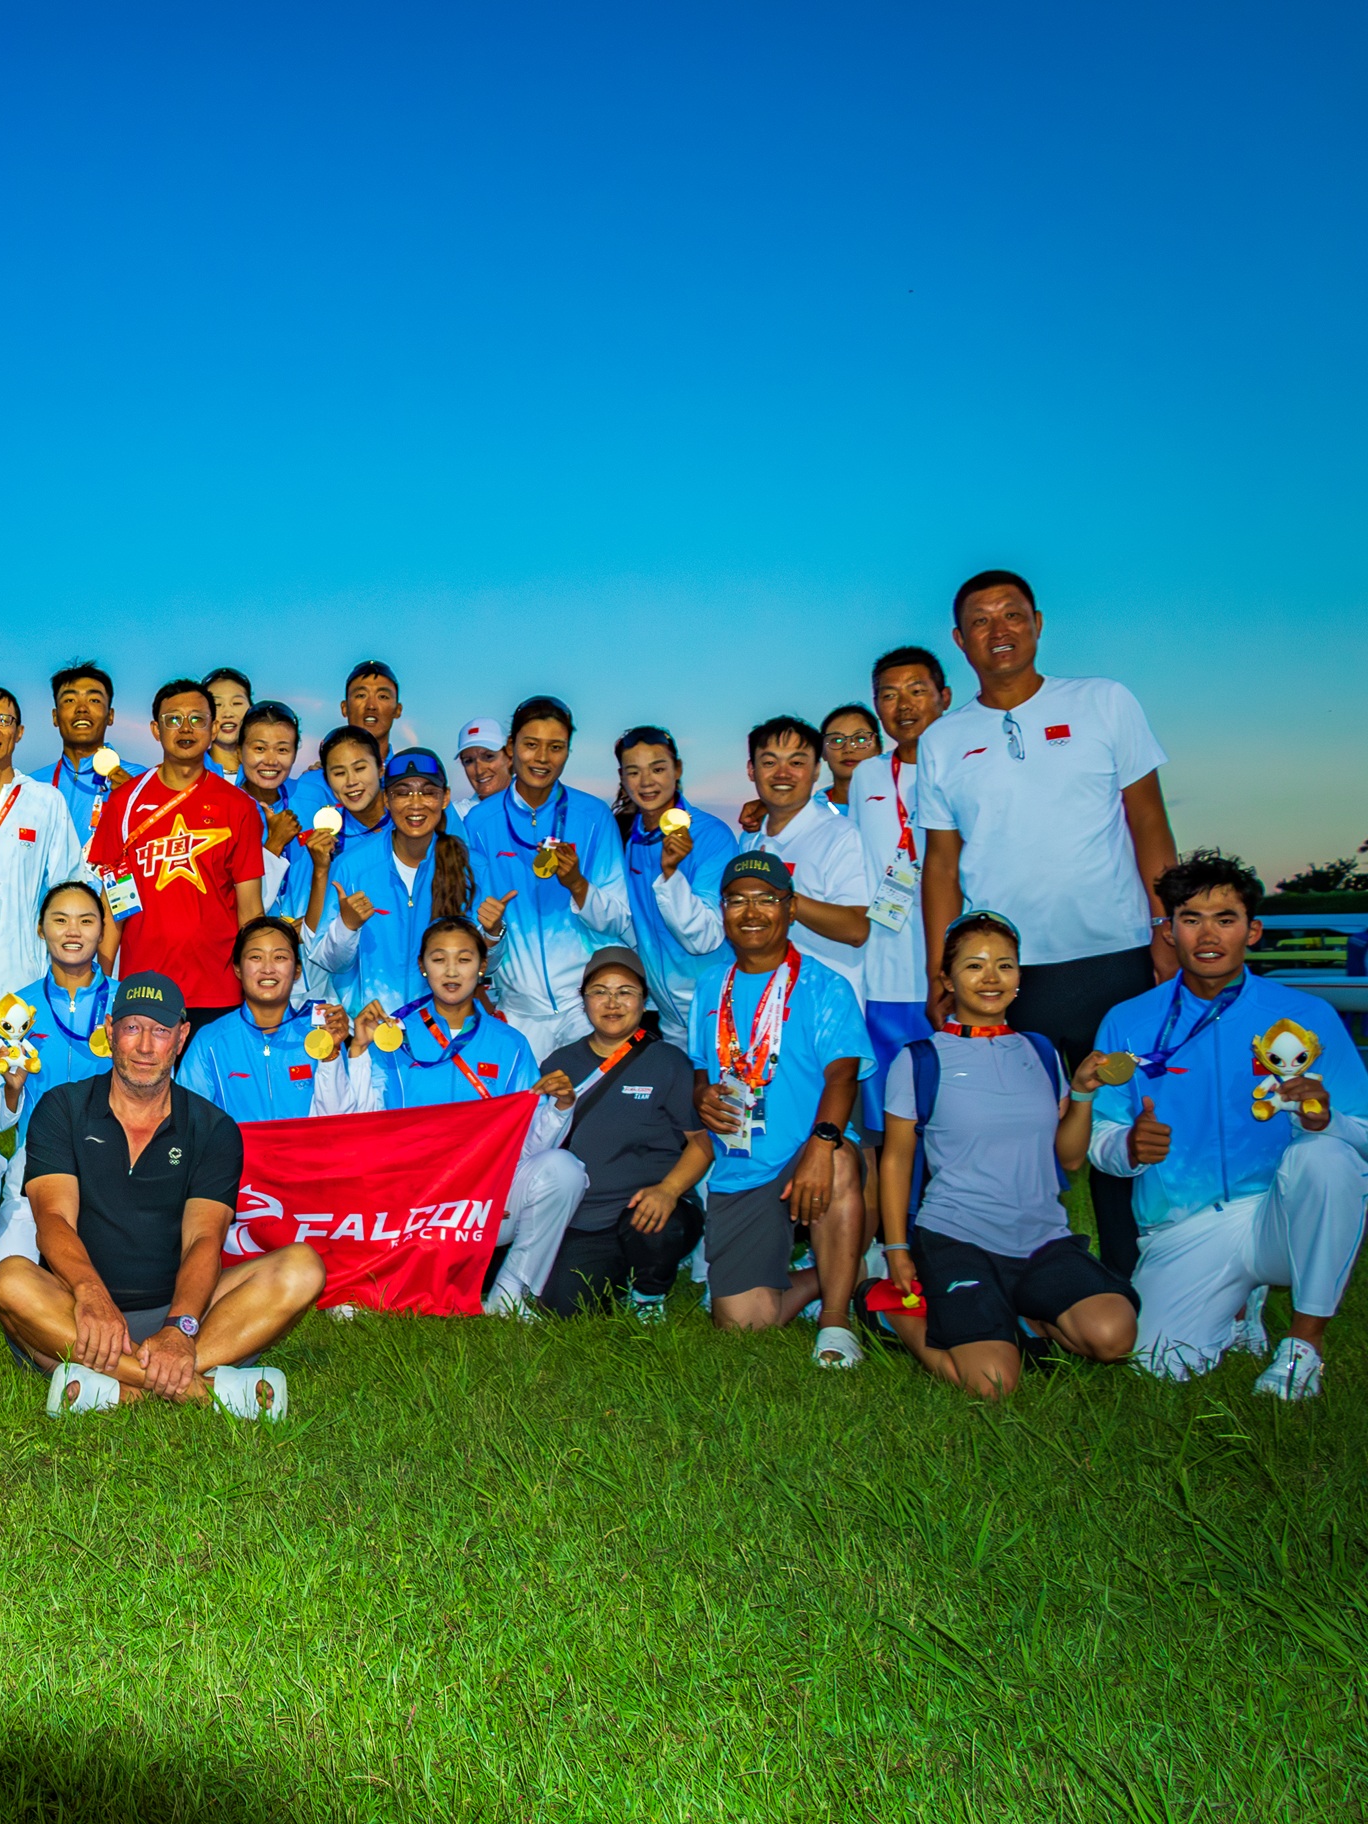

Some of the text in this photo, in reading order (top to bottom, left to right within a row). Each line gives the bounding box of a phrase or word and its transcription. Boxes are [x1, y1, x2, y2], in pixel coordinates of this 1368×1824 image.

[135, 833, 193, 877] 中国
[734, 859, 771, 872] CHINA
[126, 986, 164, 1002] CHINA
[293, 1199, 493, 1243] FALCON
